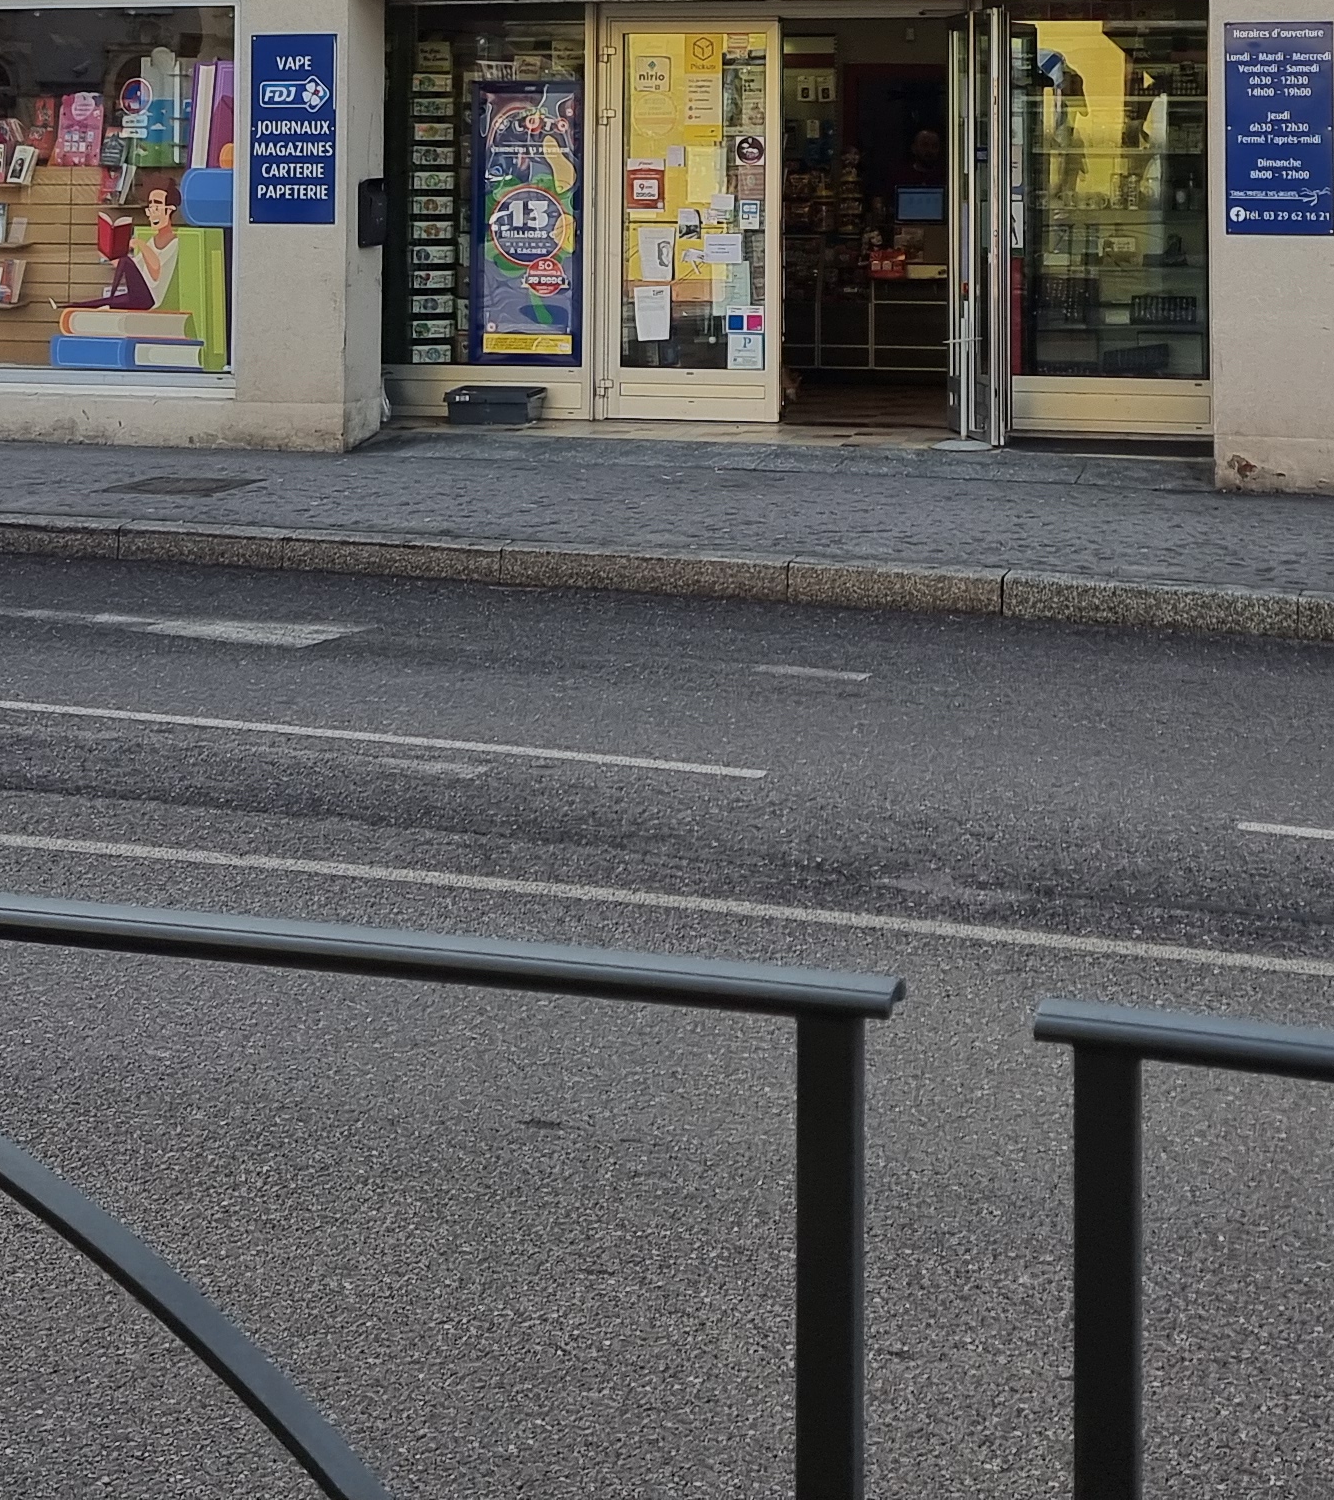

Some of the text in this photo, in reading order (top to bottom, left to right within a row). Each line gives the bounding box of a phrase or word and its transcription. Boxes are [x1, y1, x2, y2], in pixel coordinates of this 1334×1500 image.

[1233, 27, 1324, 39] Horaires d'ouverture
[1226, 52, 1250, 62] Lundi
[1258, 52, 1284, 61] Mardi
[1292, 51, 1332, 61] Mercredi
[276, 55, 312, 71] VAPE
[1237, 63, 1278, 73] Vendredi
[1286, 63, 1320, 73] Samedi
[1249, 75, 1272, 85] 6h30
[1280, 75, 1309, 85] 12h30
[263, 86, 297, 102] FDJ
[1246, 87, 1275, 97] 14h00
[1283, 87, 1312, 97] 19h00
[1266, 110, 1291, 122] Jeudi
[256, 120, 330, 138] JOURNAUX
[1249, 123, 1272, 132] 6h30
[1281, 123, 1309, 132] 12h30
[1237, 134, 1322, 146] Fermé l'après-midi
[253, 141, 333, 157] MAGAZINES
[1257, 157, 1302, 168] Dimanche
[261, 163, 325, 178] CARTERIE
[1249, 170, 1273, 179] 8h00
[1281, 170, 1310, 179] 12h00
[257, 184, 329, 199] PAPETERIE
[508, 200, 549, 228] 13
[1263, 211, 1275, 220] 03
[1277, 211, 1289, 220] 29
[1291, 211, 1303, 220] 62
[1305, 211, 1317, 220] 16
[1319, 211, 1330, 220] 21
[537, 260, 554, 270] 50
